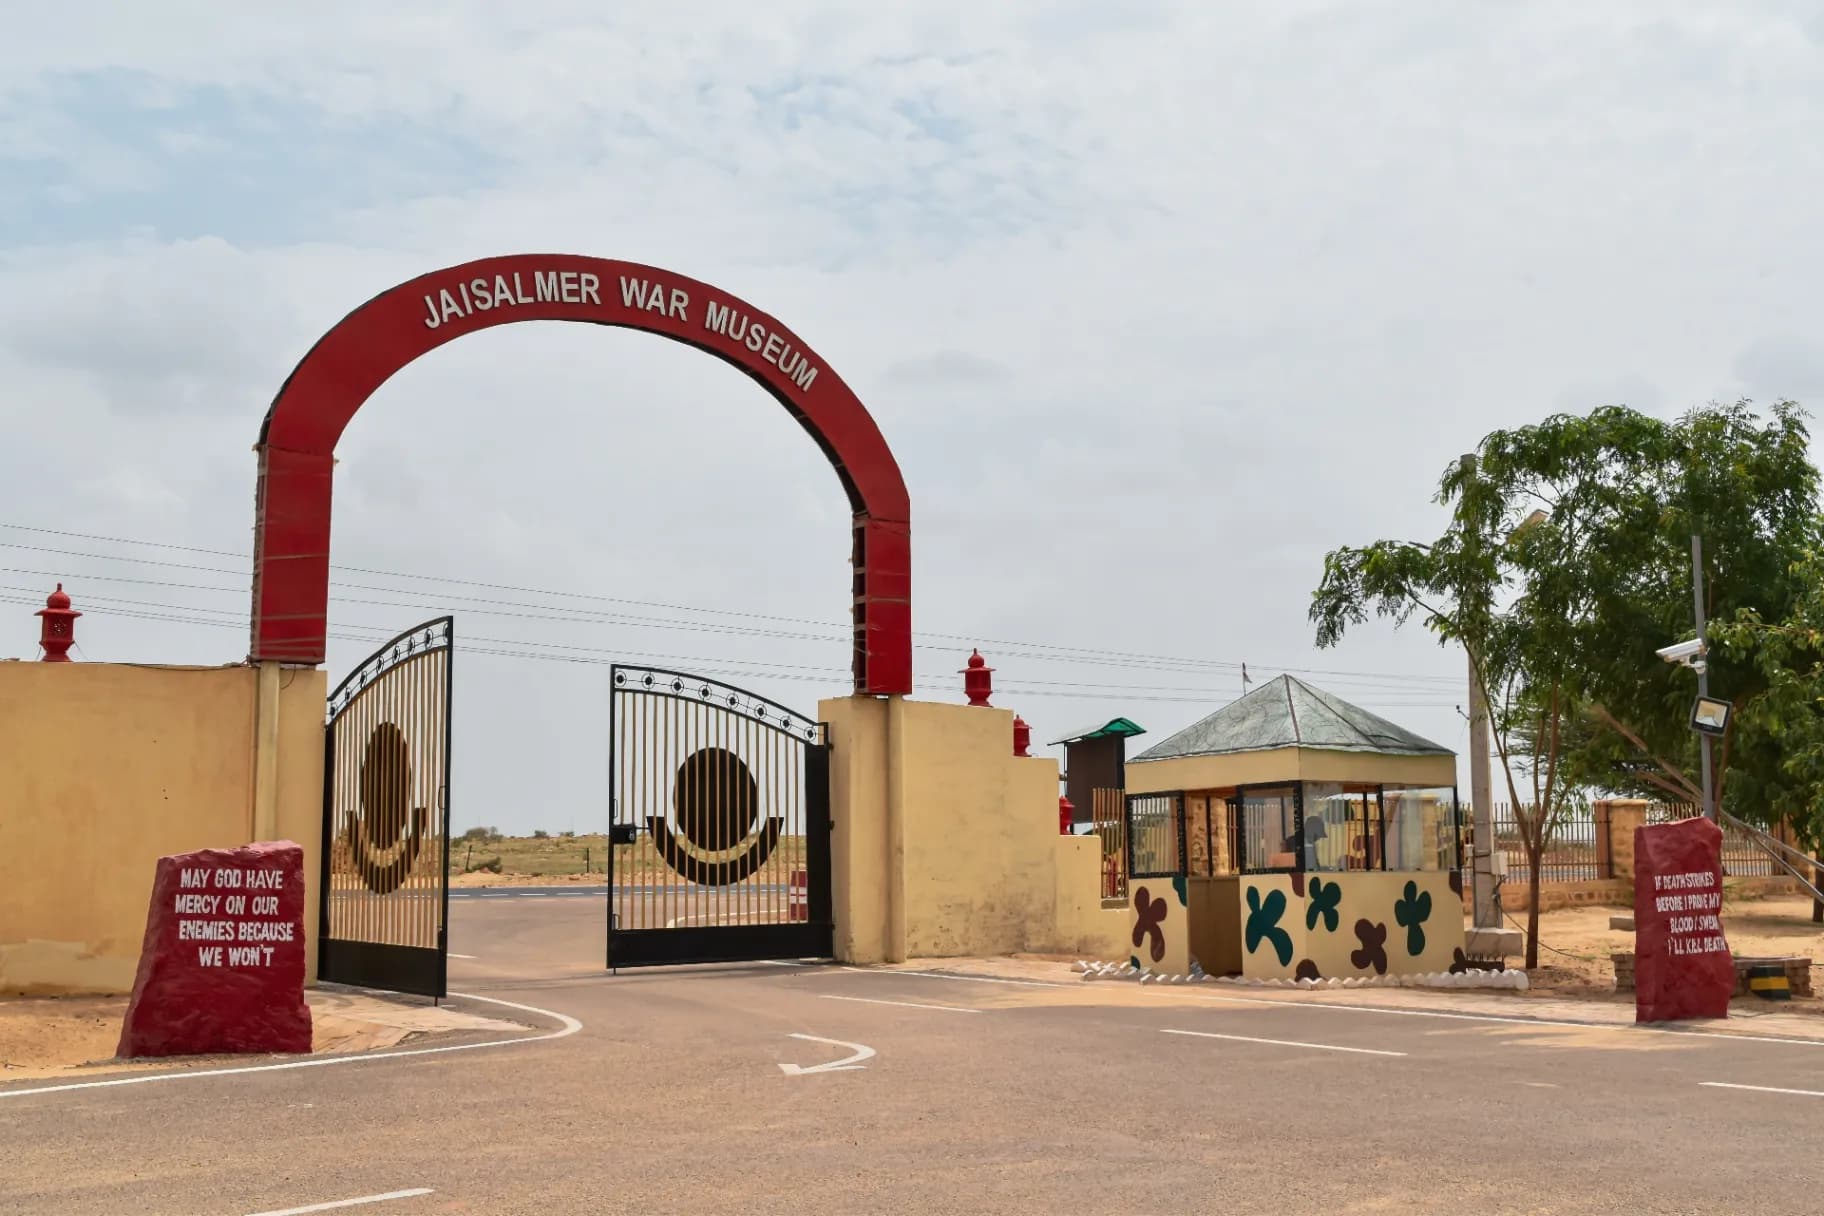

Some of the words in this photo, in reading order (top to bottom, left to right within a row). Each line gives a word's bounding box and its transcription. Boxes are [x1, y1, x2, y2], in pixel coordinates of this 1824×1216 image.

[423, 271, 602, 329] JAISALMER
[619, 275, 690, 322] WAR
[704, 301, 819, 392] MUSEUM
[180, 868, 211, 888] MAY
[214, 868, 242, 888] GOD
[245, 869, 283, 889] HAVE
[1663, 874, 1686, 889] DEATH
[1685, 871, 1715, 888] STRIKES
[175, 894, 221, 914] MERCY
[225, 895, 246, 915] ON
[252, 896, 279, 915] OUR
[1656, 895, 1684, 912] BEFORE
[1688, 894, 1708, 910] PROVE
[1708, 892, 1721, 909] MY
[179, 919, 235, 941] ENEMIES
[238, 921, 295, 941] BECAUSE
[1670, 916, 1693, 933] BLOOD
[1703, 935, 1726, 953] DEATH
[198, 947, 223, 967] WE
[228, 943, 275, 967] WON'T
